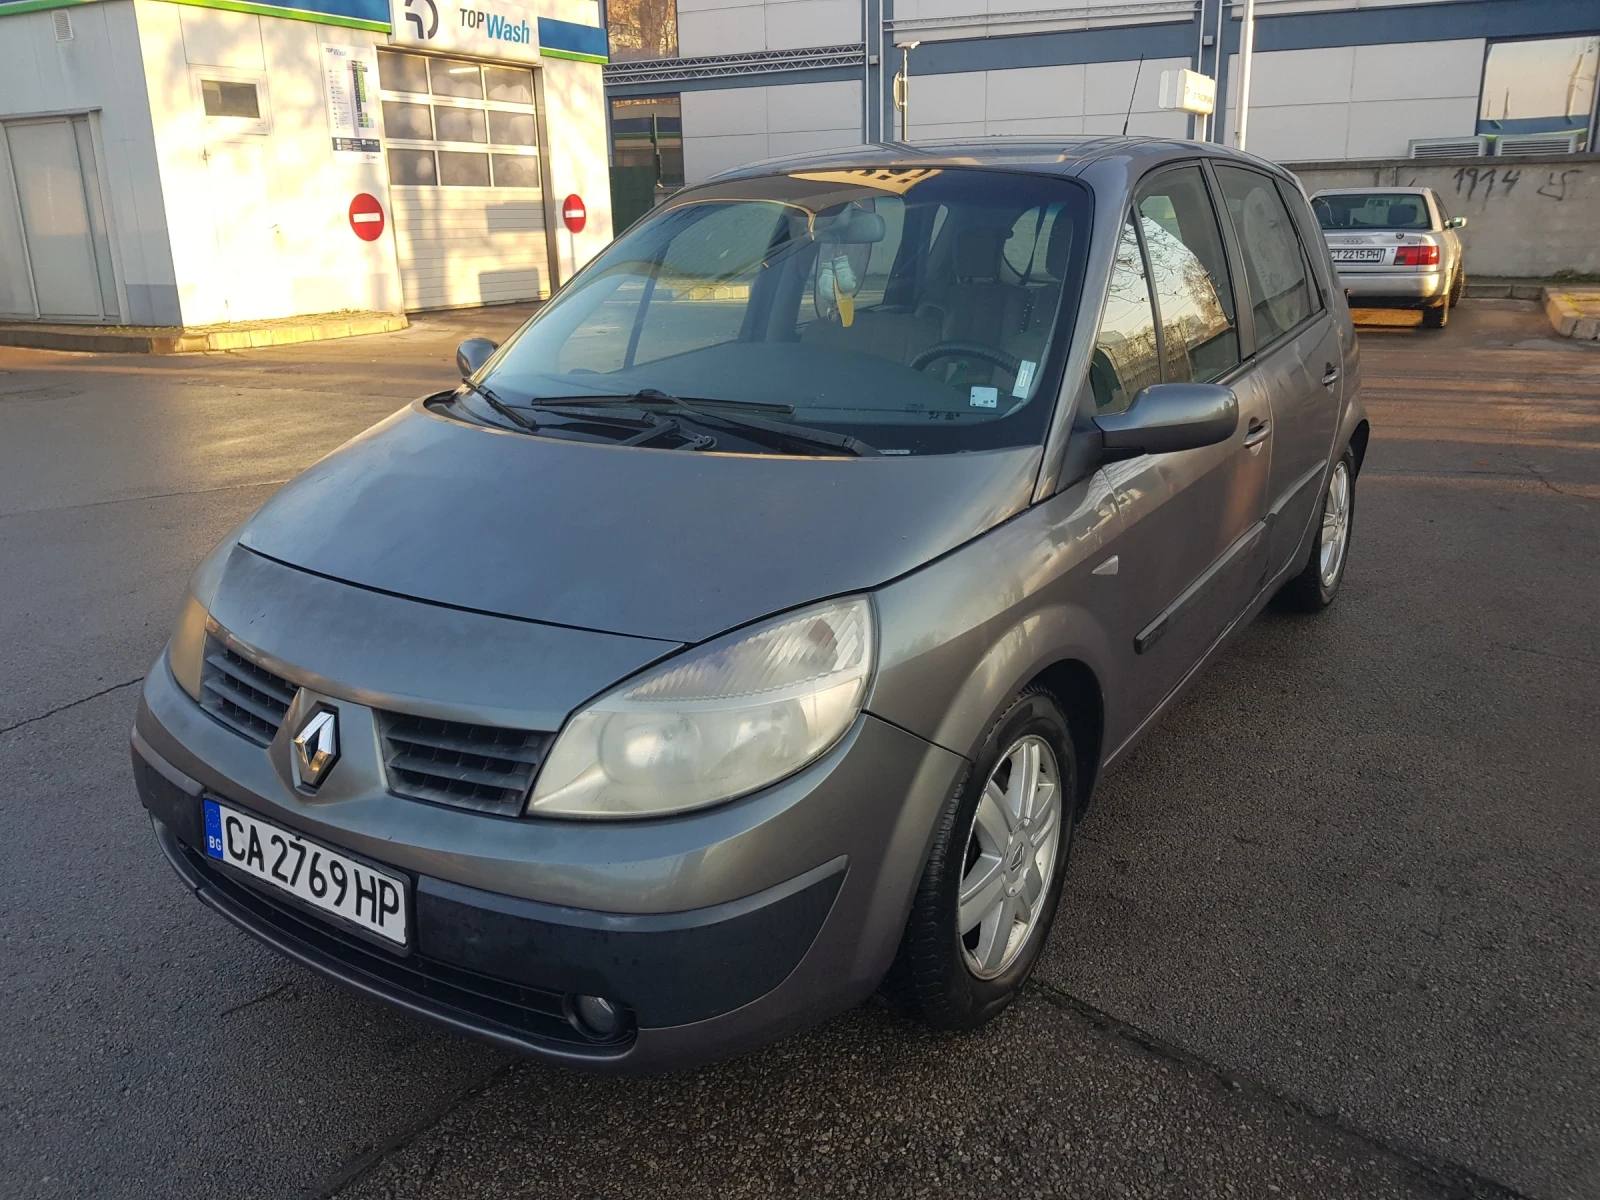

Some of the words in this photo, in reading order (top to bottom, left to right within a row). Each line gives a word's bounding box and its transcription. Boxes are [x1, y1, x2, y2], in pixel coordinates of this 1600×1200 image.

[1343, 250, 1365, 259] 2215
[1366, 250, 1379, 259] PH
[208, 836, 222, 851] BG
[225, 816, 265, 872] CA
[270, 834, 348, 907] 2769
[354, 868, 399, 927] HP
